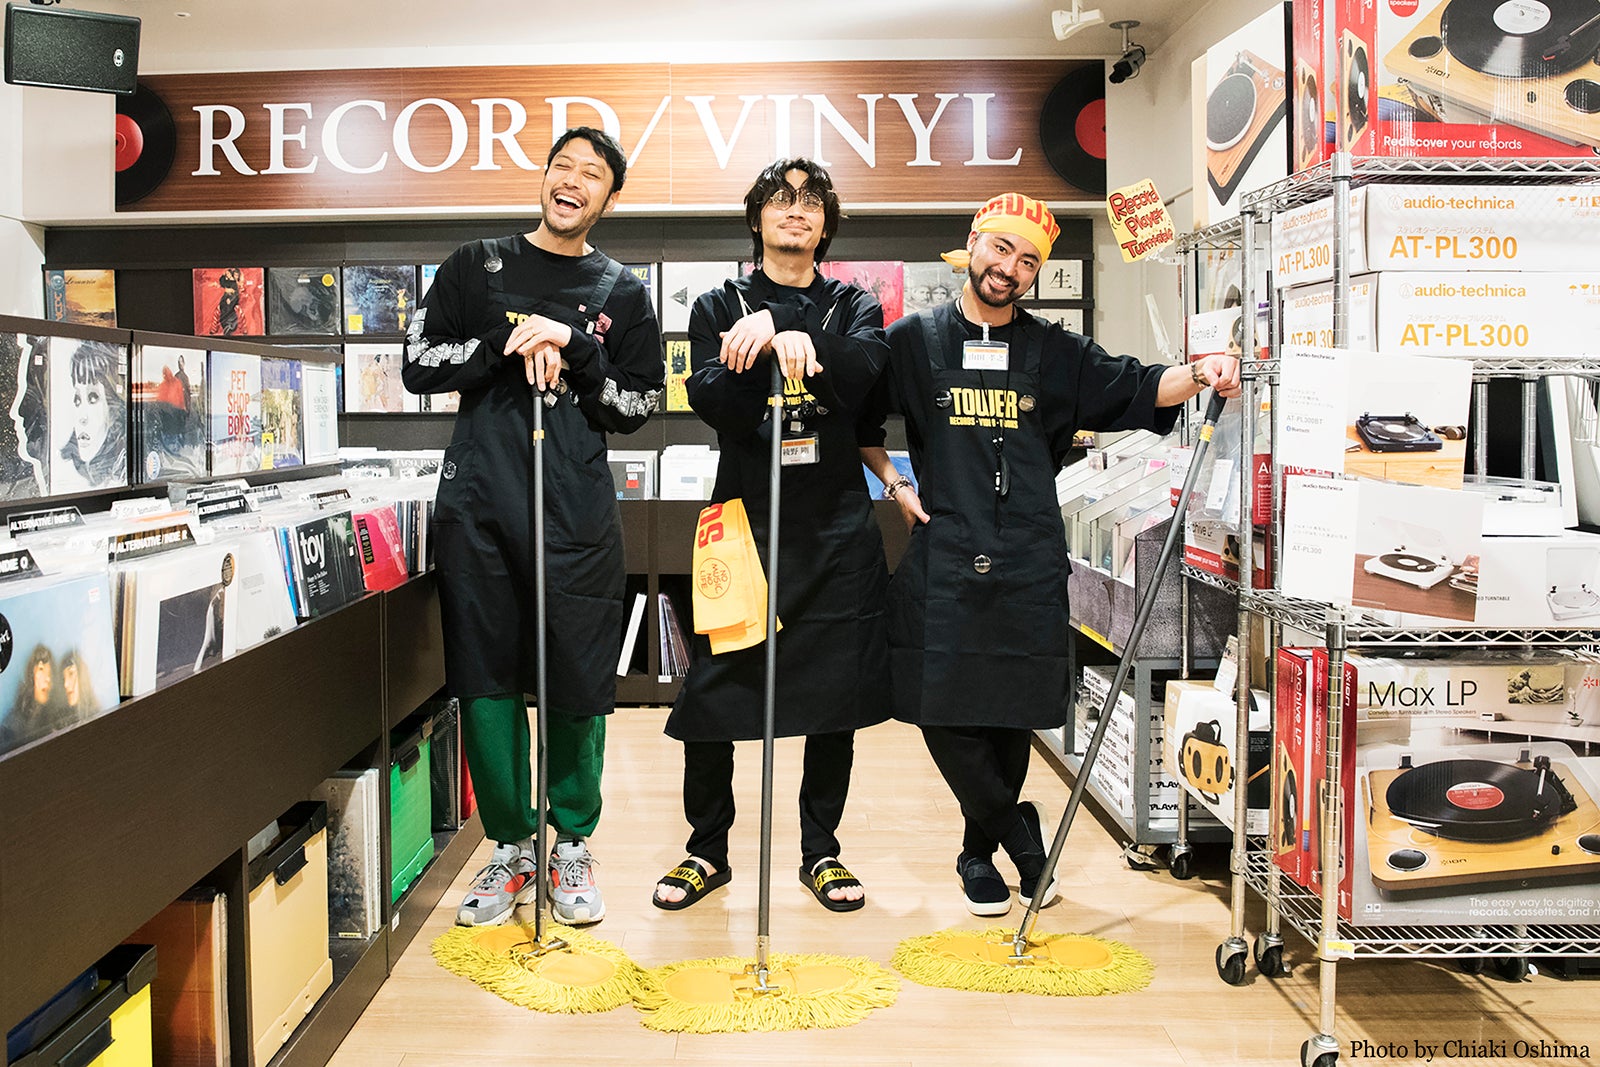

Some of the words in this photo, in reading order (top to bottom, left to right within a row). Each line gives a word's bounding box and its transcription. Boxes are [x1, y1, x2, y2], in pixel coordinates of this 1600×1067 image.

[1383, 135, 1448, 148] Rediscover
[1451, 139, 1476, 150] your
[1479, 139, 1522, 150] records
[1109, 182, 1159, 222] Record
[1403, 194, 1515, 210] audio-technica
[1124, 207, 1164, 239] Player
[1389, 235, 1518, 259] AT-PL300
[1278, 243, 1330, 276] AT-PL300
[1049, 267, 1073, 289] 生
[1414, 283, 1527, 298] audio-technica
[1399, 323, 1529, 347] AT-PL300
[231, 370, 247, 391] PET
[227, 392, 250, 414] SHOP
[950, 387, 1018, 419] TOWER
[227, 415, 251, 436] BOYS
[299, 531, 325, 570] toy
[20, 555, 28, 569] Q
[700, 569, 709, 590] LIFE
[707, 572, 714, 586] NO
[711, 563, 723, 594] MUSIC
[719, 569, 728, 583] NO
[1295, 664, 1304, 724] Archive
[1368, 680, 1435, 707] Max
[1446, 680, 1478, 706] LP
[1453, 708, 1477, 716] Speakers
[1294, 728, 1302, 746] LP
[1469, 897, 1488, 907] The
[1491, 898, 1517, 909] easy
[1519, 898, 1541, 909] way
[1542, 897, 1554, 907] to
[1556, 897, 1594, 909] digitize
[1469, 907, 1511, 917] records,
[1513, 907, 1566, 917] cassettes,
[1568, 907, 1590, 917] and
